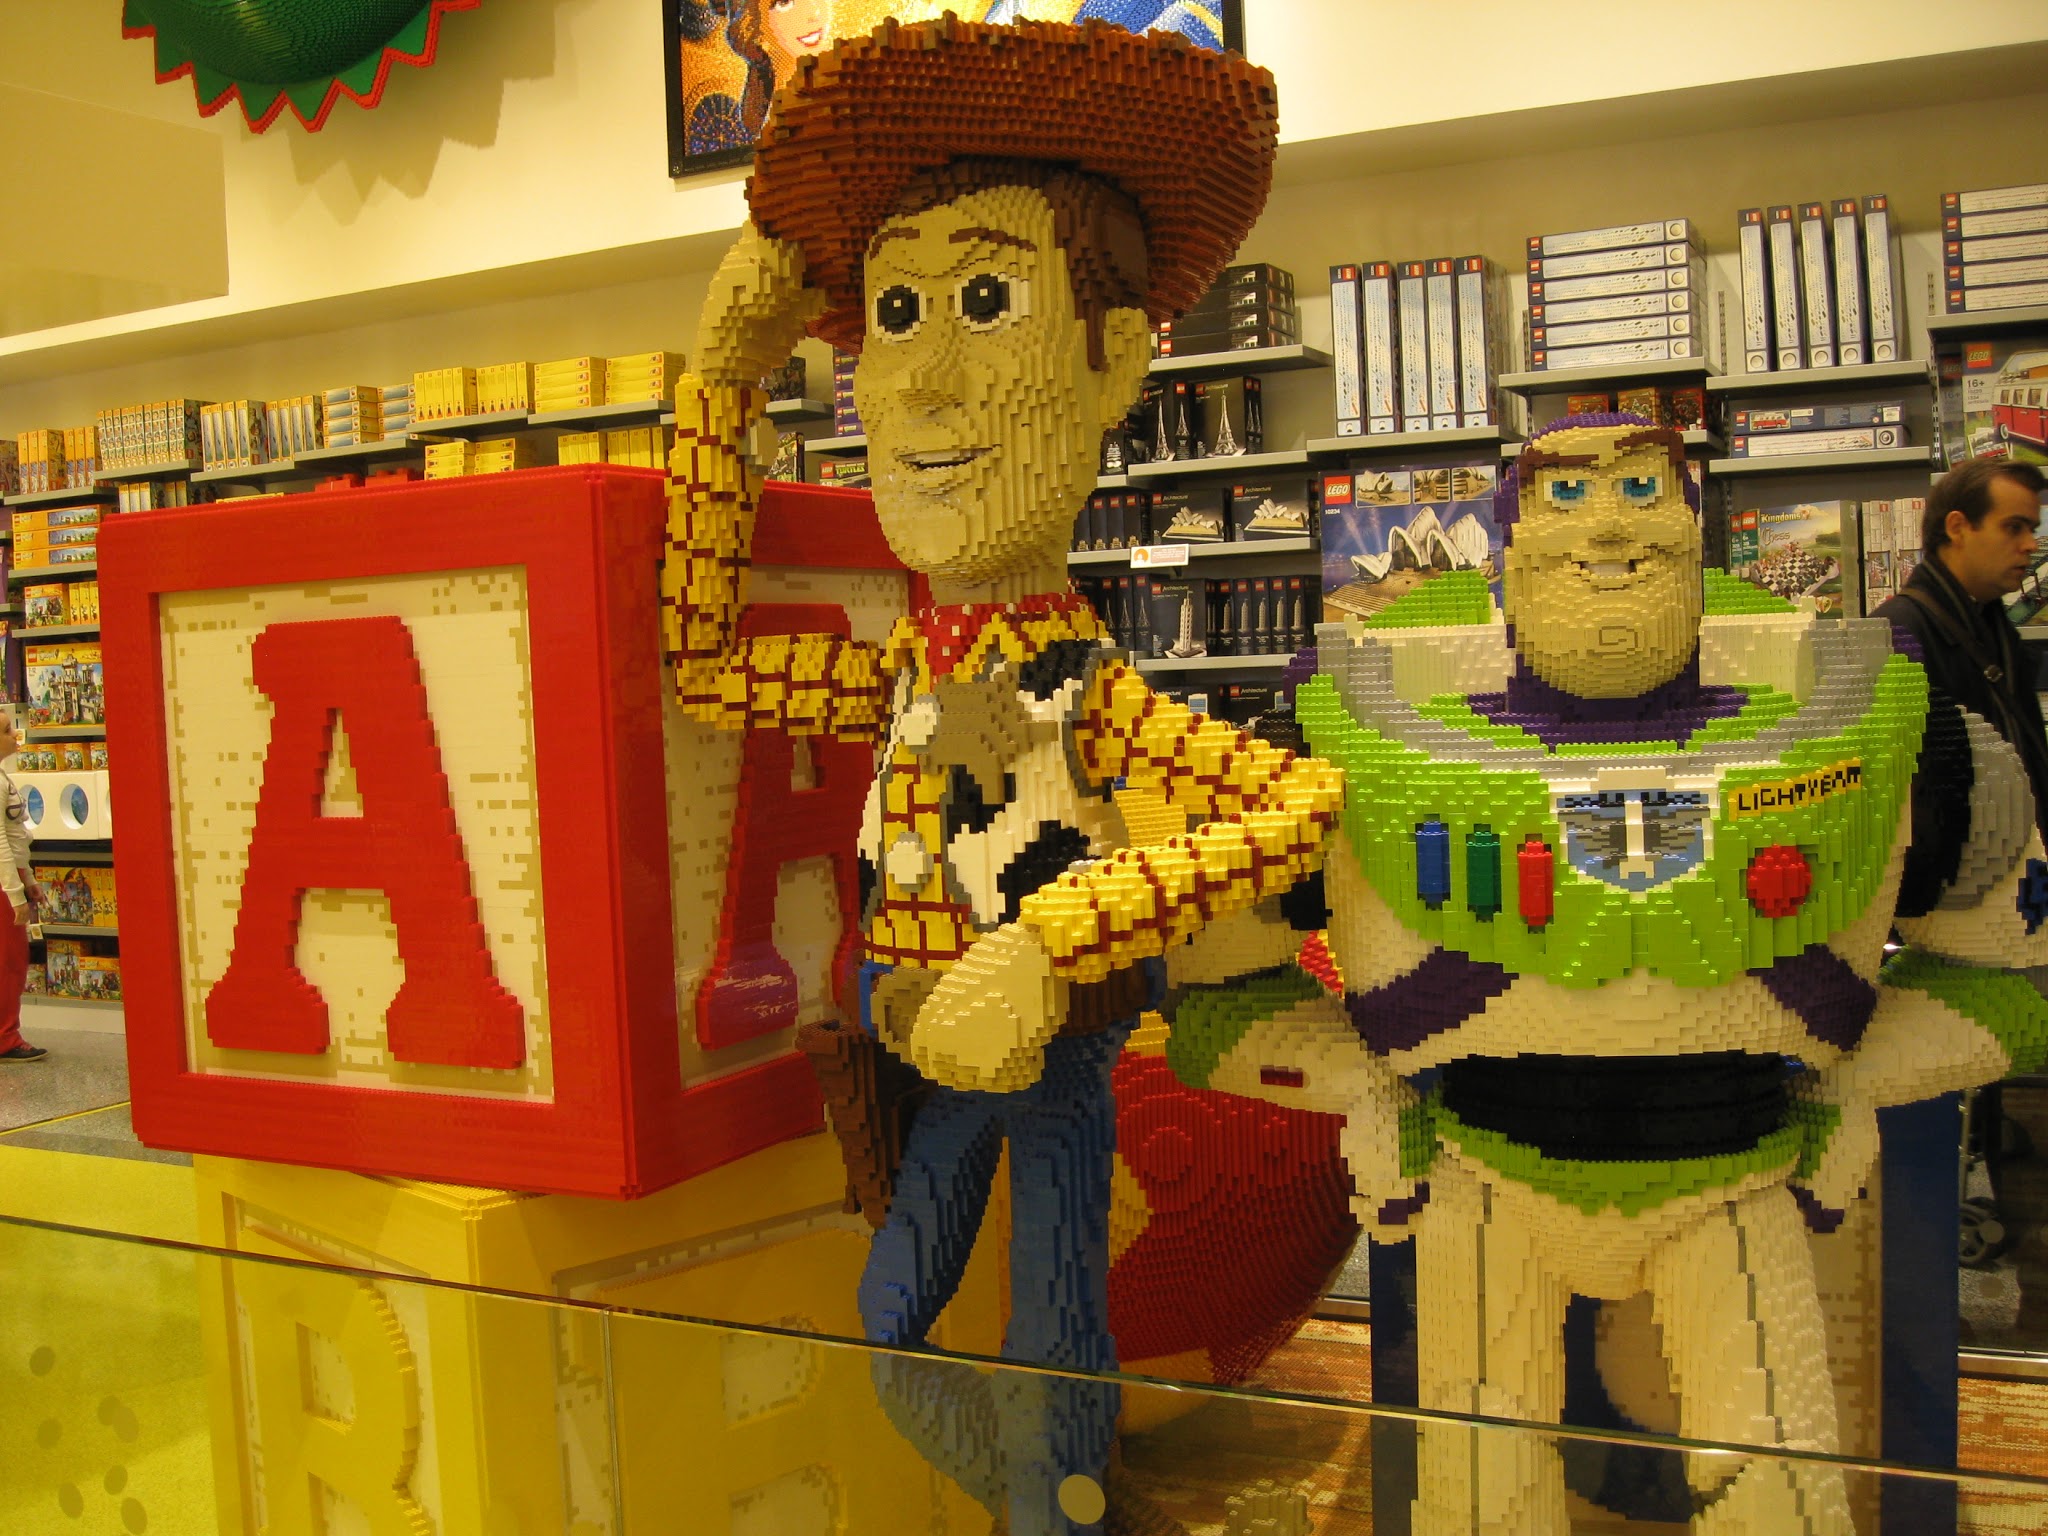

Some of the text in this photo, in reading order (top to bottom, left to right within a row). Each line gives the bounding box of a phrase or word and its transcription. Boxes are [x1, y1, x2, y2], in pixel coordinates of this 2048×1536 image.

[1968, 350, 1990, 361] LEGO
[1967, 379, 1984, 388] 16+
[1326, 484, 1350, 496] LEGO
[1761, 511, 1801, 523] Kingdoms
[1761, 527, 1790, 545] Chess
[1739, 766, 1860, 810] LIGHTYEAR
[206, 615, 525, 1069] A
